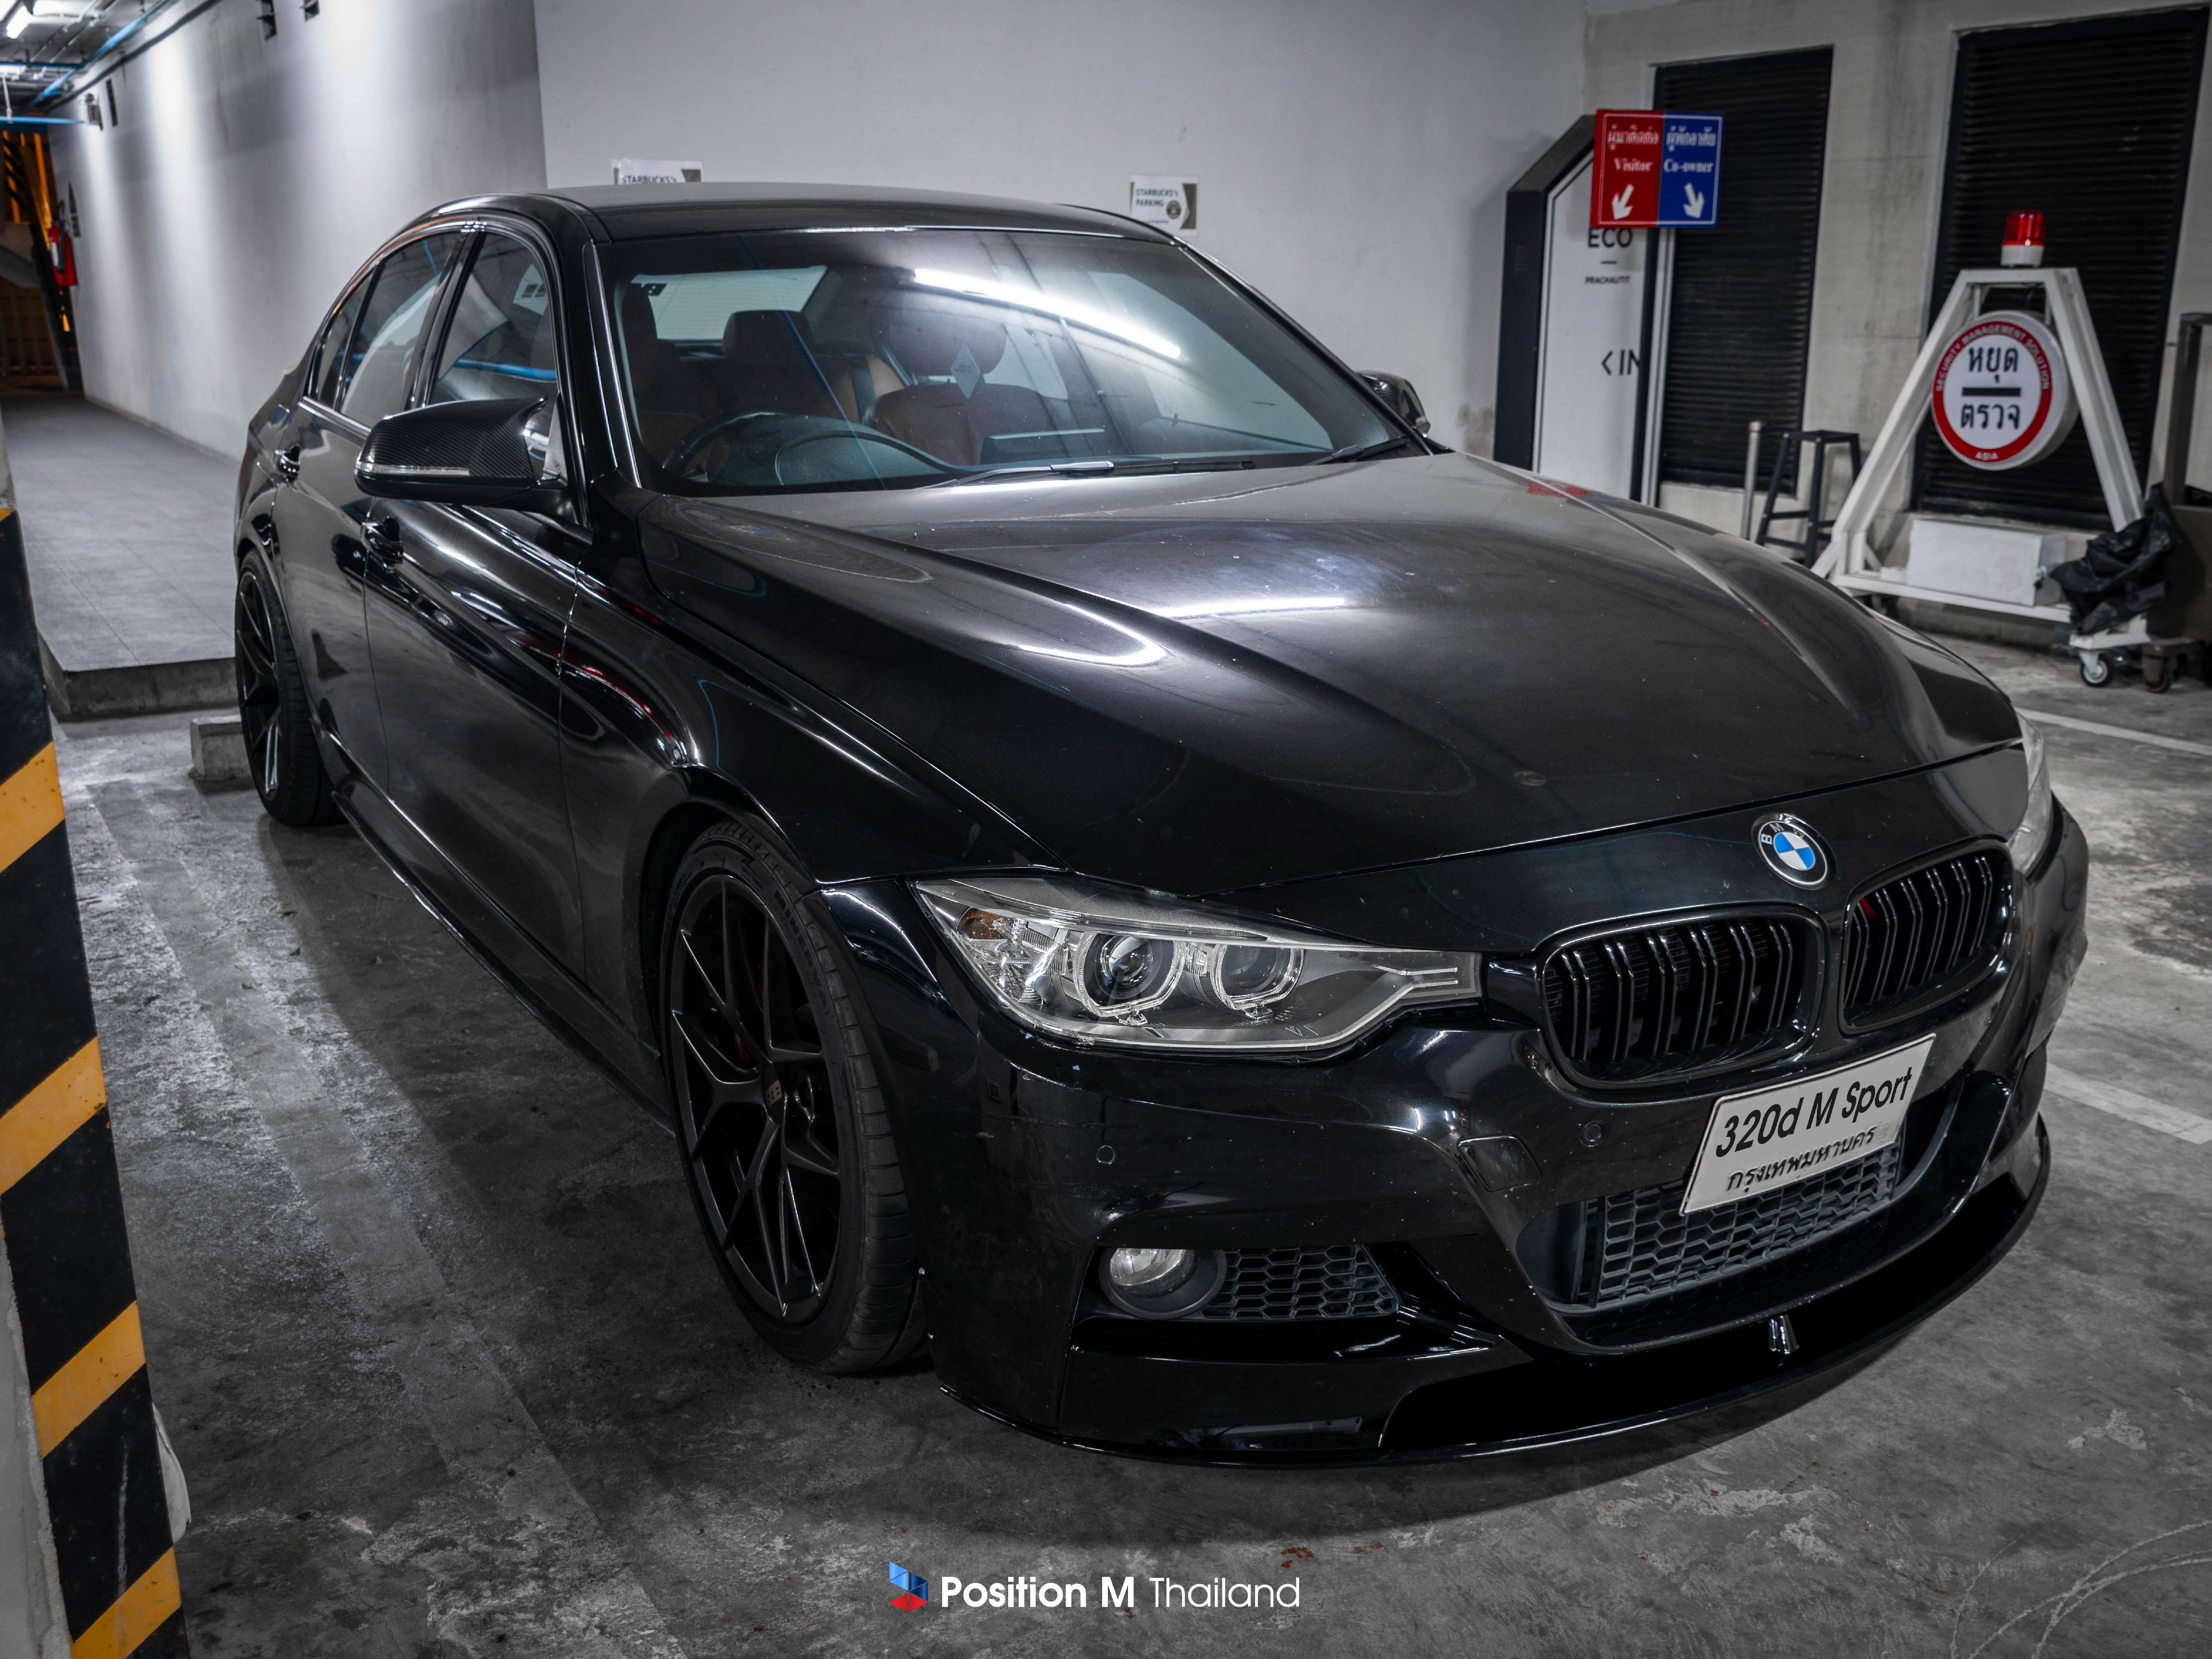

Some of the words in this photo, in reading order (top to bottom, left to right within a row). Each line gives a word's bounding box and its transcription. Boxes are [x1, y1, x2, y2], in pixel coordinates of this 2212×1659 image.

[1614, 158, 1653, 172] Visitor
[1663, 158, 1714, 172] Co-owner
[1936, 343, 1962, 391] SECURITY
[1961, 324, 2027, 345] MANAGEMENT
[2026, 339, 2050, 389] SOLUTION
[1969, 347, 2020, 383] หยุด
[1961, 404, 2021, 430] ตรวจ
[1975, 451, 1999, 460] ASIA
[1715, 1097, 1804, 1158] 320d
[1805, 1087, 1839, 1130] M
[1842, 1066, 1912, 1123] Sport
[1726, 1126, 1878, 1193] กรุงเทพมหานคร
